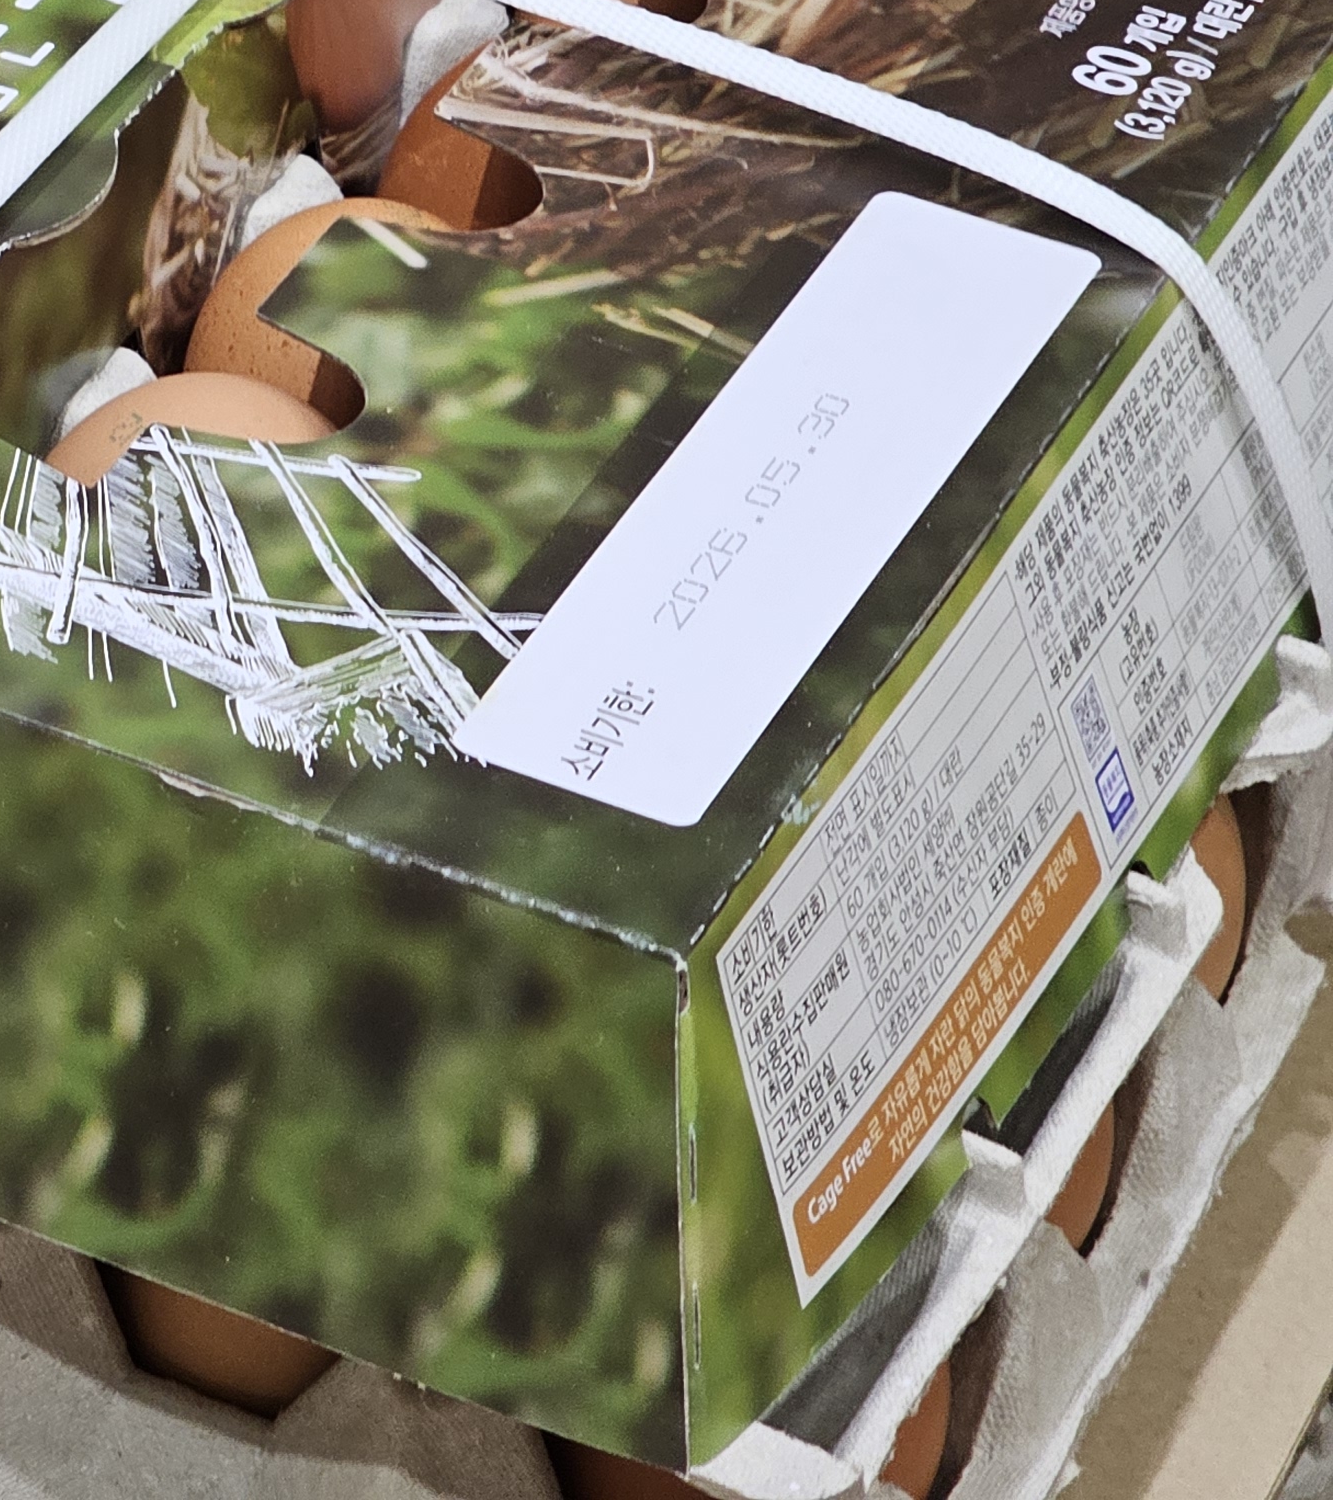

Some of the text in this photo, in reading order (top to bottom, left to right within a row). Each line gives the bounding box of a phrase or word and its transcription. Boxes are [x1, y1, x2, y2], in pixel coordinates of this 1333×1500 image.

[1071, 4, 1188, 97] 60 개입
[1113, 74, 1193, 141] (3,120
[1166, 49, 1217, 82] g)
[1167, 472, 1193, 513] 1399
[863, 711, 1047, 983] 경기도 안성시 35-29
[1034, 786, 1060, 834] 종이
[846, 884, 865, 920] 60
[855, 849, 923, 955] 농업회사법인
[988, 826, 1032, 901] 포장재질
[874, 894, 953, 1014] 080-670-0114
[746, 987, 786, 1050] 내용량
[762, 1038, 811, 1115] (취급자)
[772, 1052, 838, 1159] 고객상담실
[781, 1049, 876, 1193] 보관방법 온도
[887, 1035, 974, 1164] 자연의 건강함을
[807, 1114, 885, 1225] Cage Free로
